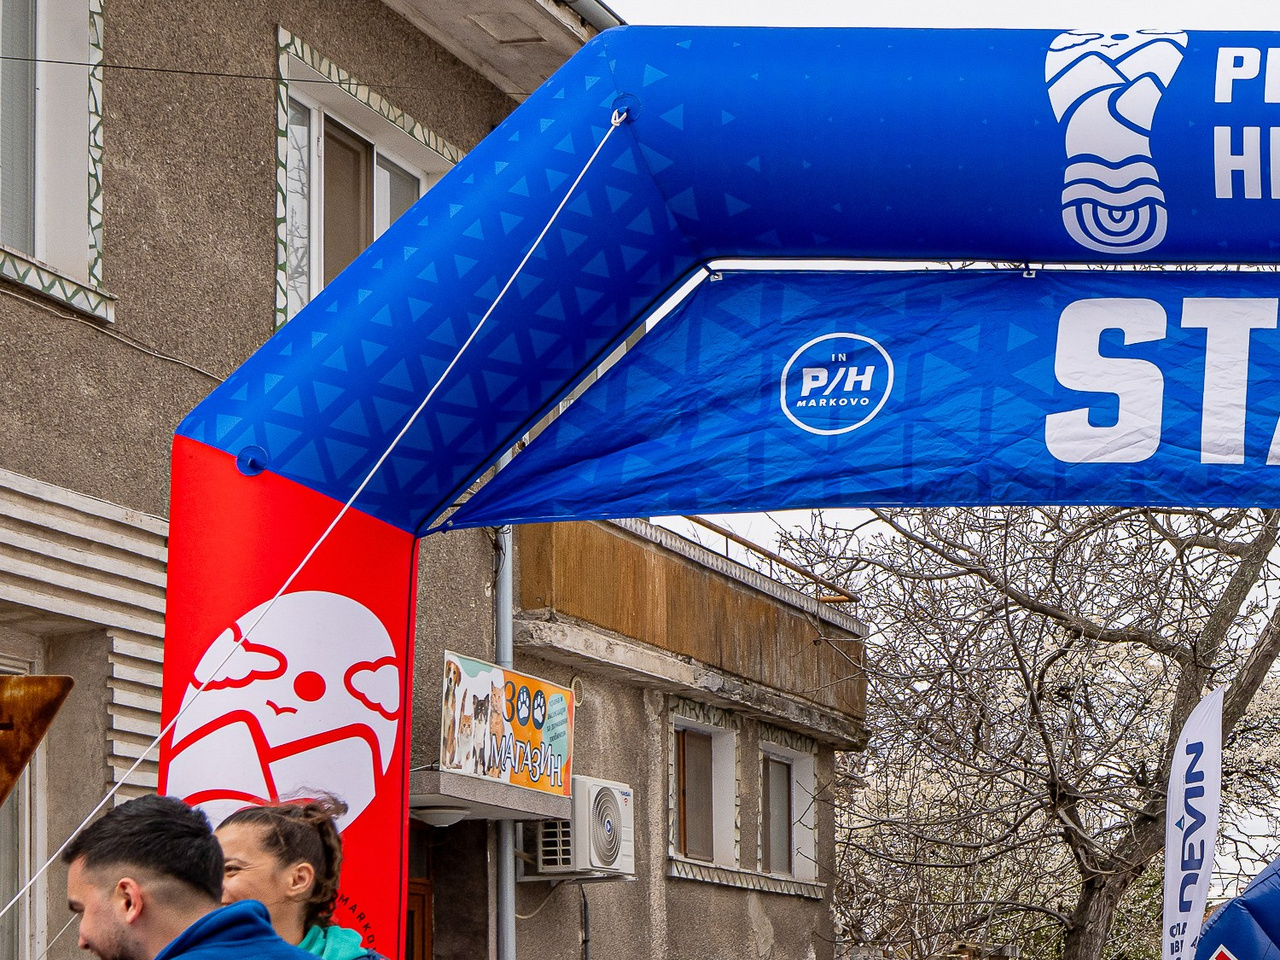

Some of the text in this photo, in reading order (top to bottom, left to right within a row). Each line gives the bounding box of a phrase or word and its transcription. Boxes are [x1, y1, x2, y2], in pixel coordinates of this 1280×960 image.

[831, 353, 847, 362] IN
[801, 365, 875, 397] P/H
[796, 397, 870, 407] MARKOVO
[489, 733, 563, 787] МАГАЗИН
[338, 894, 377, 951] MARKO
